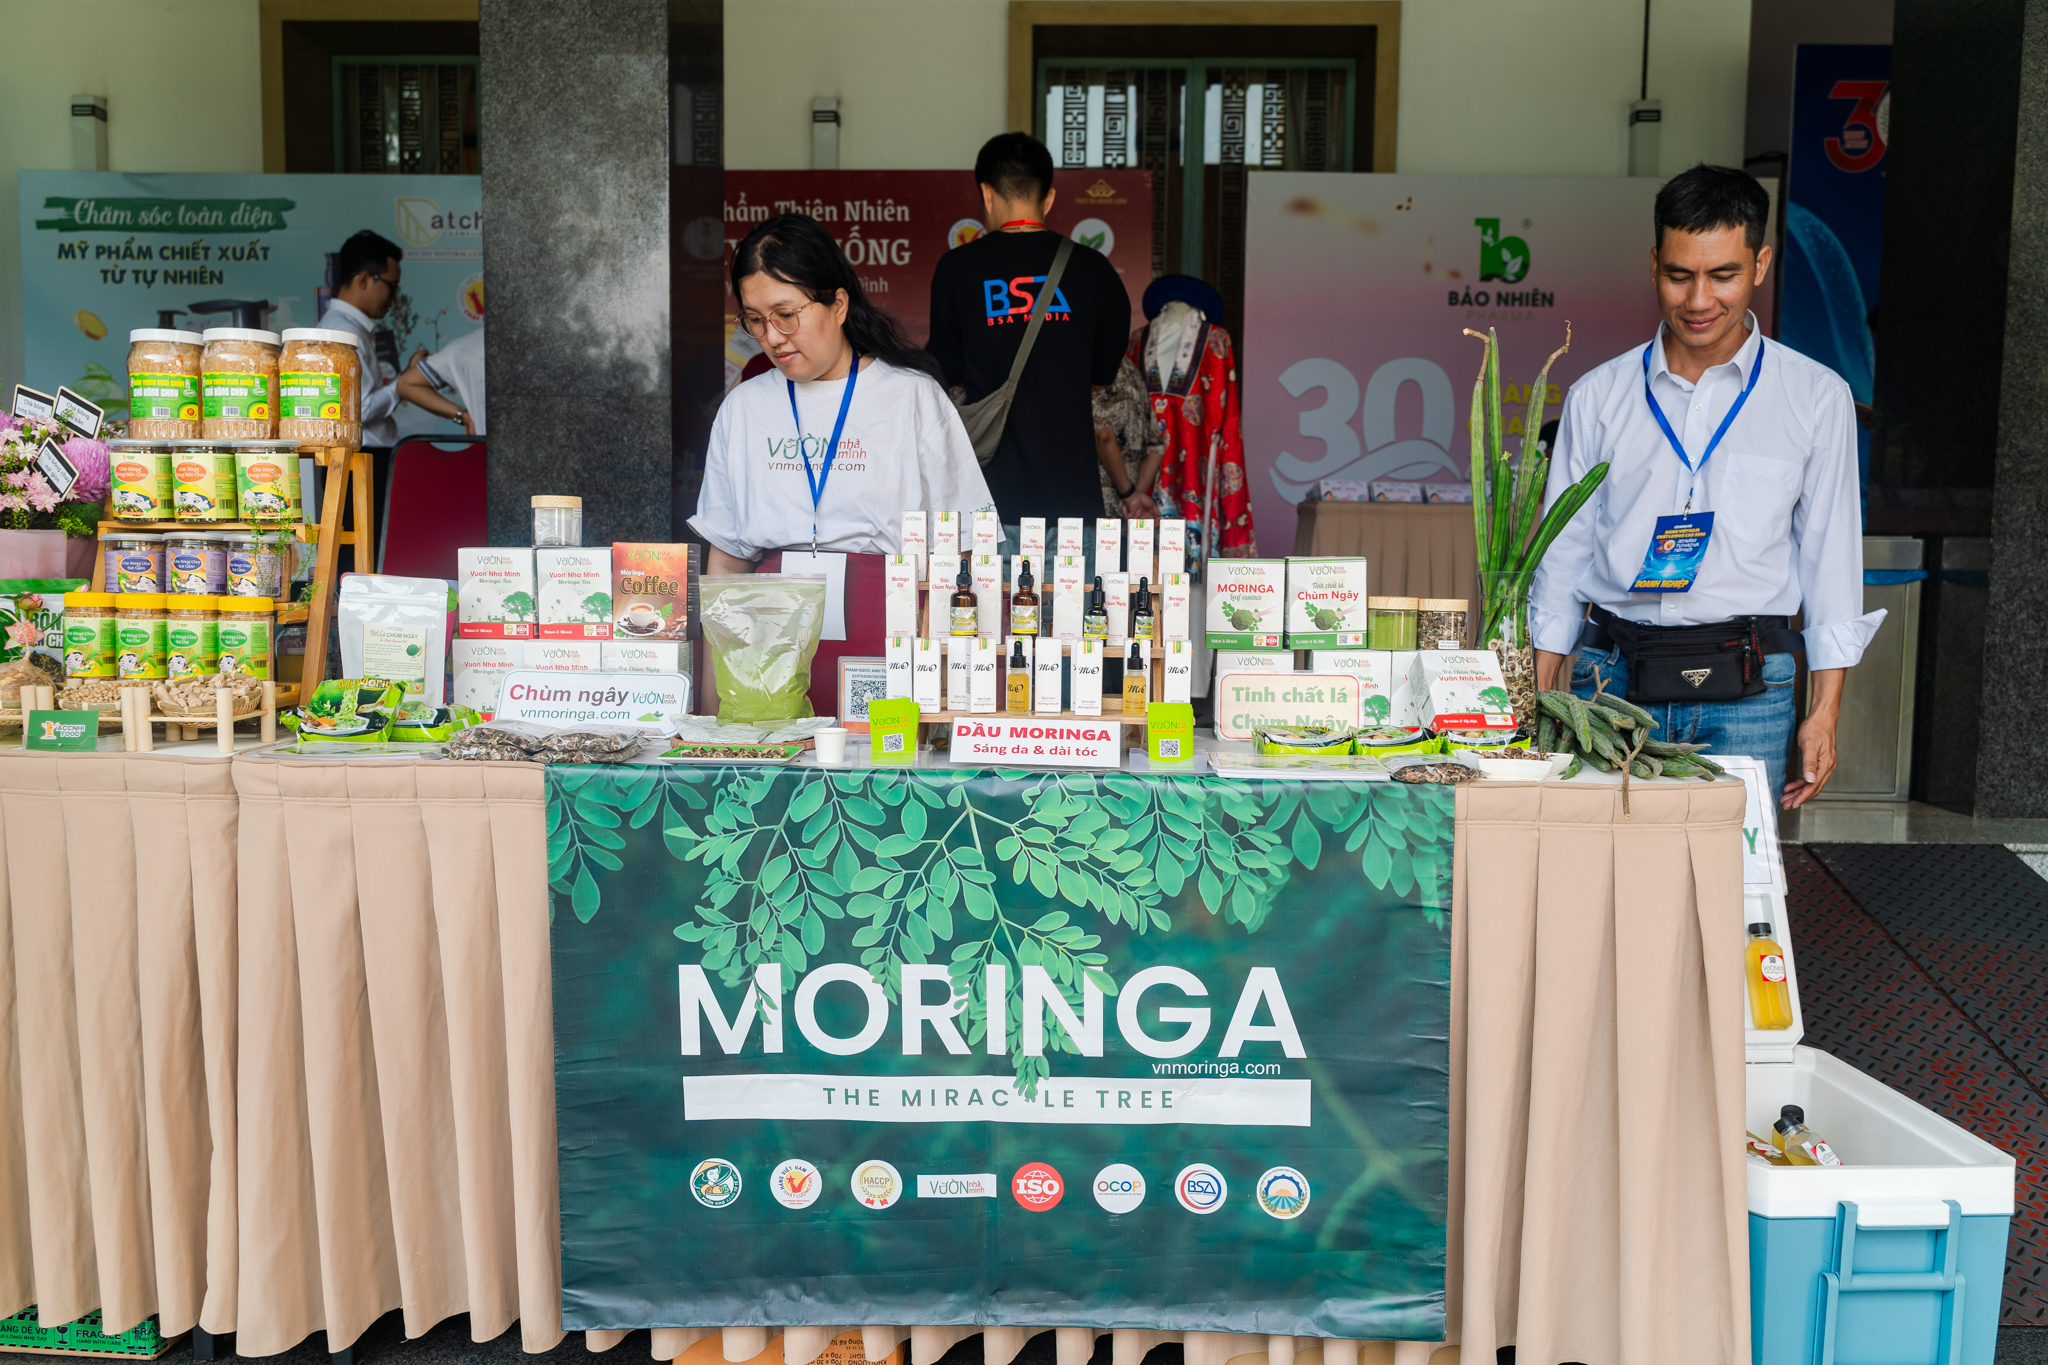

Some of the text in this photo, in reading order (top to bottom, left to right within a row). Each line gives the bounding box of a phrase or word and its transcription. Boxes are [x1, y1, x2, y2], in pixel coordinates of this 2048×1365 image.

[724, 192, 910, 222] hẩm Thiên Nhiên
[74, 200, 276, 229] Chăm sóc toàn diện
[57, 236, 271, 262] MỸ PHẨM CHIẾT XUẤT
[838, 225, 912, 266] ỐNG
[100, 264, 224, 289] TỪ TỰ NHIÊN
[983, 275, 1072, 318] BSA
[1449, 286, 1555, 308] BẢO NHIÊN
[987, 312, 1070, 326] BSA MDIA
[1467, 311, 1535, 322] PHARMA
[839, 438, 860, 449] nhà
[838, 448, 866, 459] mình
[477, 555, 503, 566] VƯỜN
[626, 548, 660, 562] VƯỜN
[556, 556, 582, 566] VƯỜN
[470, 570, 521, 578] Vuon Nha Minh
[549, 571, 600, 579] Vuon Nha Minh
[620, 569, 645, 577] Moringa
[1228, 566, 1255, 575] VƯỜN
[1309, 565, 1336, 575] VƯỜN
[619, 575, 679, 595] Coffee
[1217, 584, 1274, 593] MORINGA
[1297, 590, 1359, 601] Chùm Ngây
[471, 646, 496, 656] VƯỜN
[543, 648, 570, 659] VƯỜN
[621, 648, 647, 659] VƯỜN
[1237, 656, 1264, 666] VƯỜN
[1333, 658, 1361, 668] VƯỜN
[509, 684, 571, 701] Chùm
[579, 687, 629, 706] ngây
[632, 691, 664, 704] VƯỜN
[1232, 686, 1348, 704] Tinh chất lá
[520, 708, 630, 721] vnmoringa.com
[872, 716, 900, 726] VƯỜN
[1150, 720, 1177, 729] VƯỜN
[957, 722, 1111, 741] DẦU MORINGA
[973, 743, 1098, 757] Sáng da & dài tóc
[678, 963, 1307, 1058] MORINGA
[1151, 1060, 1281, 1078] vnmoringa.com
[822, 1086, 881, 1108] THE
[1096, 1088, 1176, 1110] TREE
[864, 1177, 889, 1185] HACCP
[929, 1178, 969, 1194] VƯỜN
[1016, 1178, 1060, 1195] ISO
[1098, 1181, 1142, 1192] OCOP
[1188, 1180, 1216, 1195] BSA
[0, 1323, 19, 1333] ÀNG
